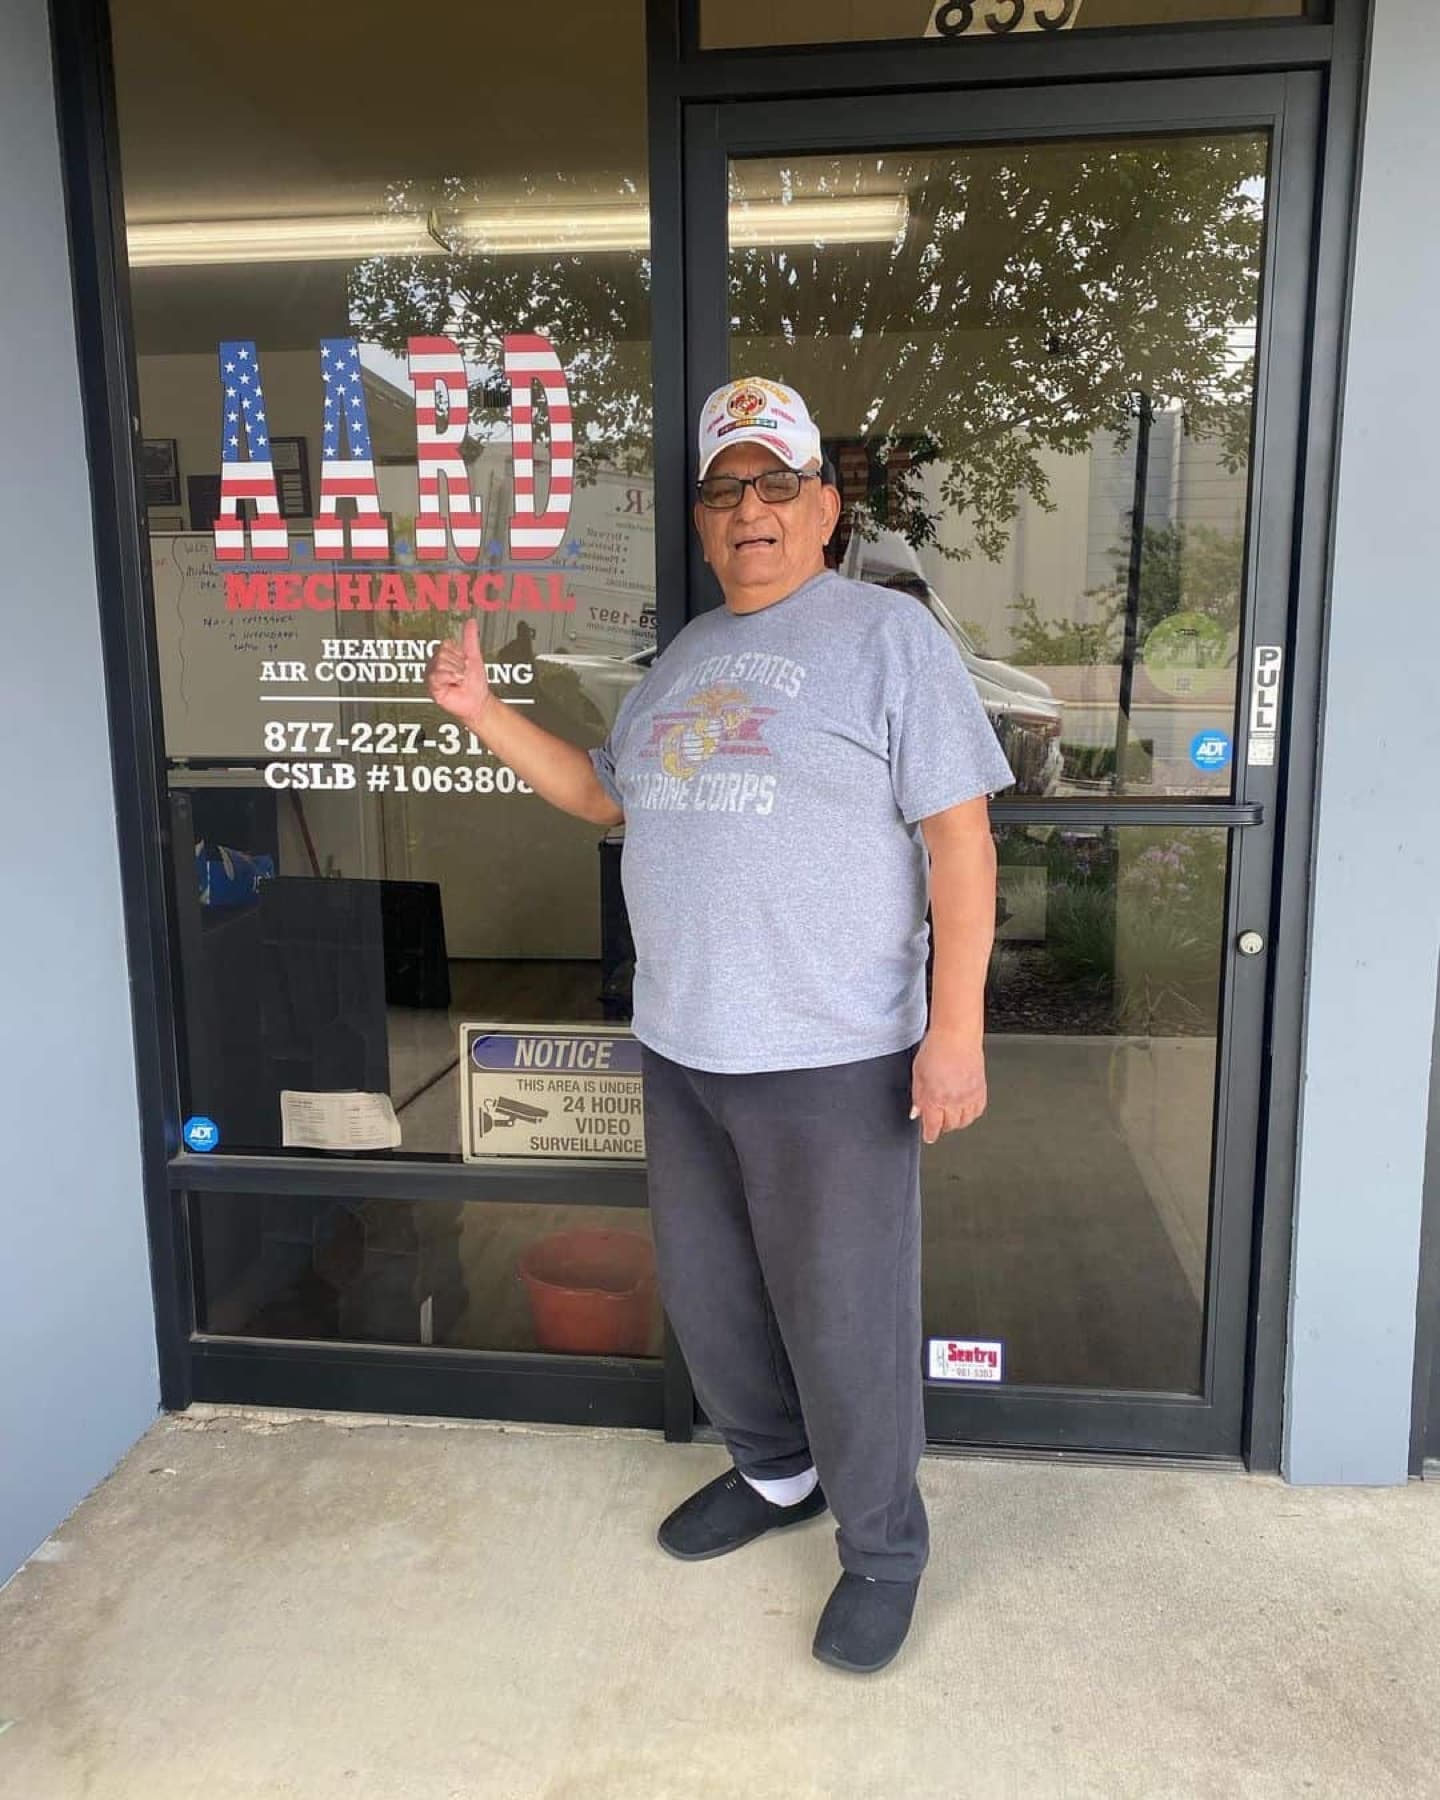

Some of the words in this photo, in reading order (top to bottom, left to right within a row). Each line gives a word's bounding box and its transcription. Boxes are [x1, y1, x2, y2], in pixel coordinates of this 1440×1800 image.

[214, 334, 576, 563] AARD
[224, 572, 577, 612] MECHANICAL
[259, 661, 309, 682] AIR
[315, 661, 534, 685] CONDITING
[730, 651, 806, 698] STATES
[1255, 649, 1279, 729] PULL
[264, 721, 495, 756] 877-227-31
[1195, 741, 1228, 757] ADT
[264, 762, 357, 790] CSLB
[693, 769, 777, 816] CORPS
[514, 1038, 614, 1069] NOTICE
[517, 1078, 544, 1092] THIS
[548, 1080, 579, 1094] AREA
[584, 1081, 596, 1093] IS
[599, 1081, 641, 1095] UNDER
[563, 1096, 585, 1113] 24
[592, 1097, 641, 1115] HOUR
[190, 1126, 214, 1140] ADT
[576, 1118, 631, 1136] VIDEO
[530, 1136, 643, 1153] SURVEILLANCE
[947, 1343, 997, 1368] Sentry
